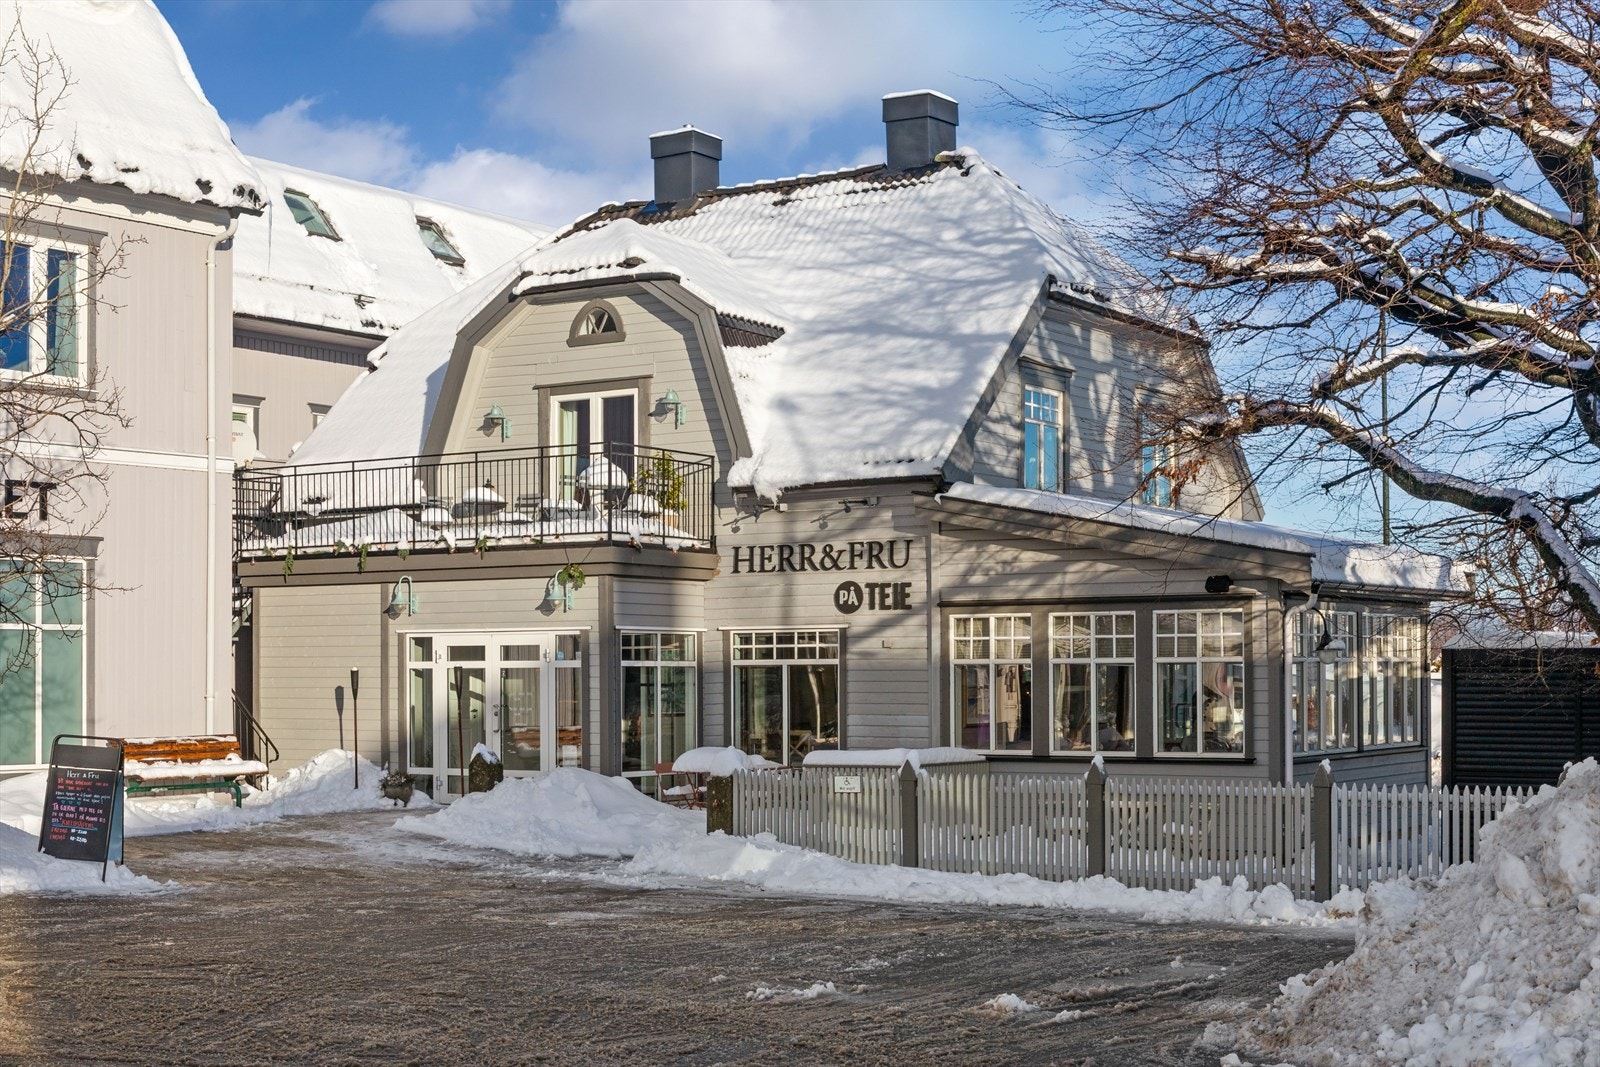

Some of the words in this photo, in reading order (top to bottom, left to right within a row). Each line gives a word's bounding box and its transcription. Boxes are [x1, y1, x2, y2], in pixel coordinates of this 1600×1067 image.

[0, 479, 58, 521] ET
[730, 539, 912, 574] HERR&FRU
[838, 586, 859, 606] PÅ
[864, 582, 913, 611] TEIE
[66, 770, 81, 779] Herr
[87, 771, 100, 779] Fru
